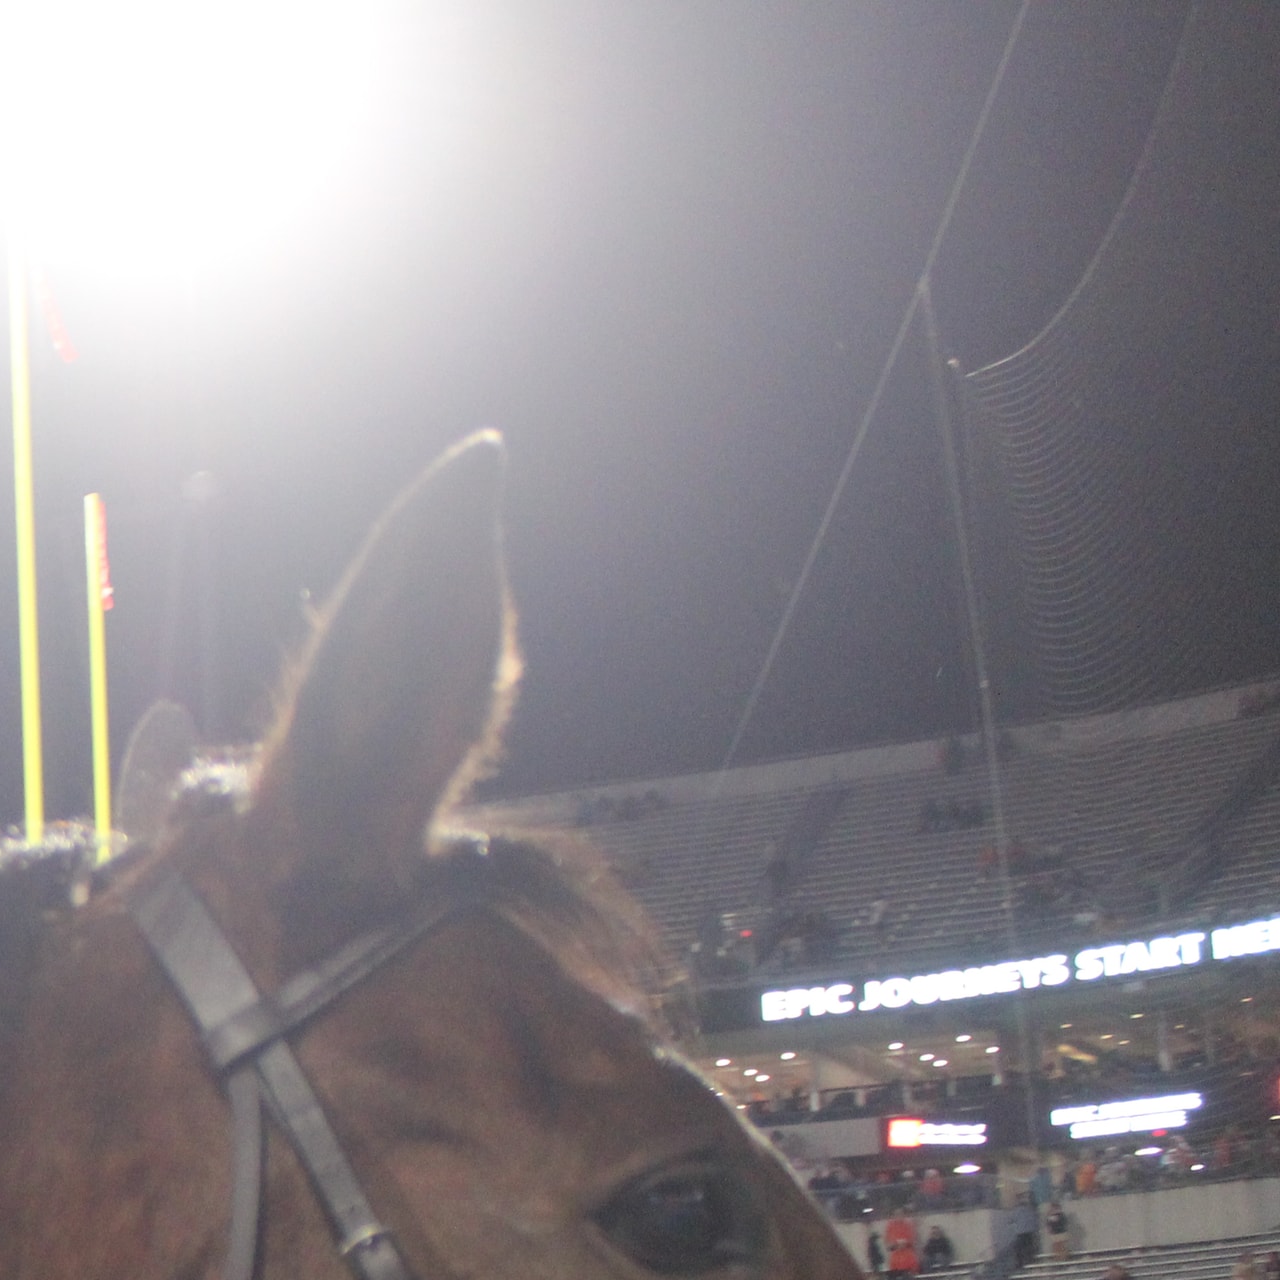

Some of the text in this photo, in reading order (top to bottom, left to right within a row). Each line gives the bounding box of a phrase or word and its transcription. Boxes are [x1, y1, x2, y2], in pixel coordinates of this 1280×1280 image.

[761, 984, 854, 1022] EPIC
[858, 955, 1070, 1011] JOURNEYS
[1075, 932, 1206, 981] START
